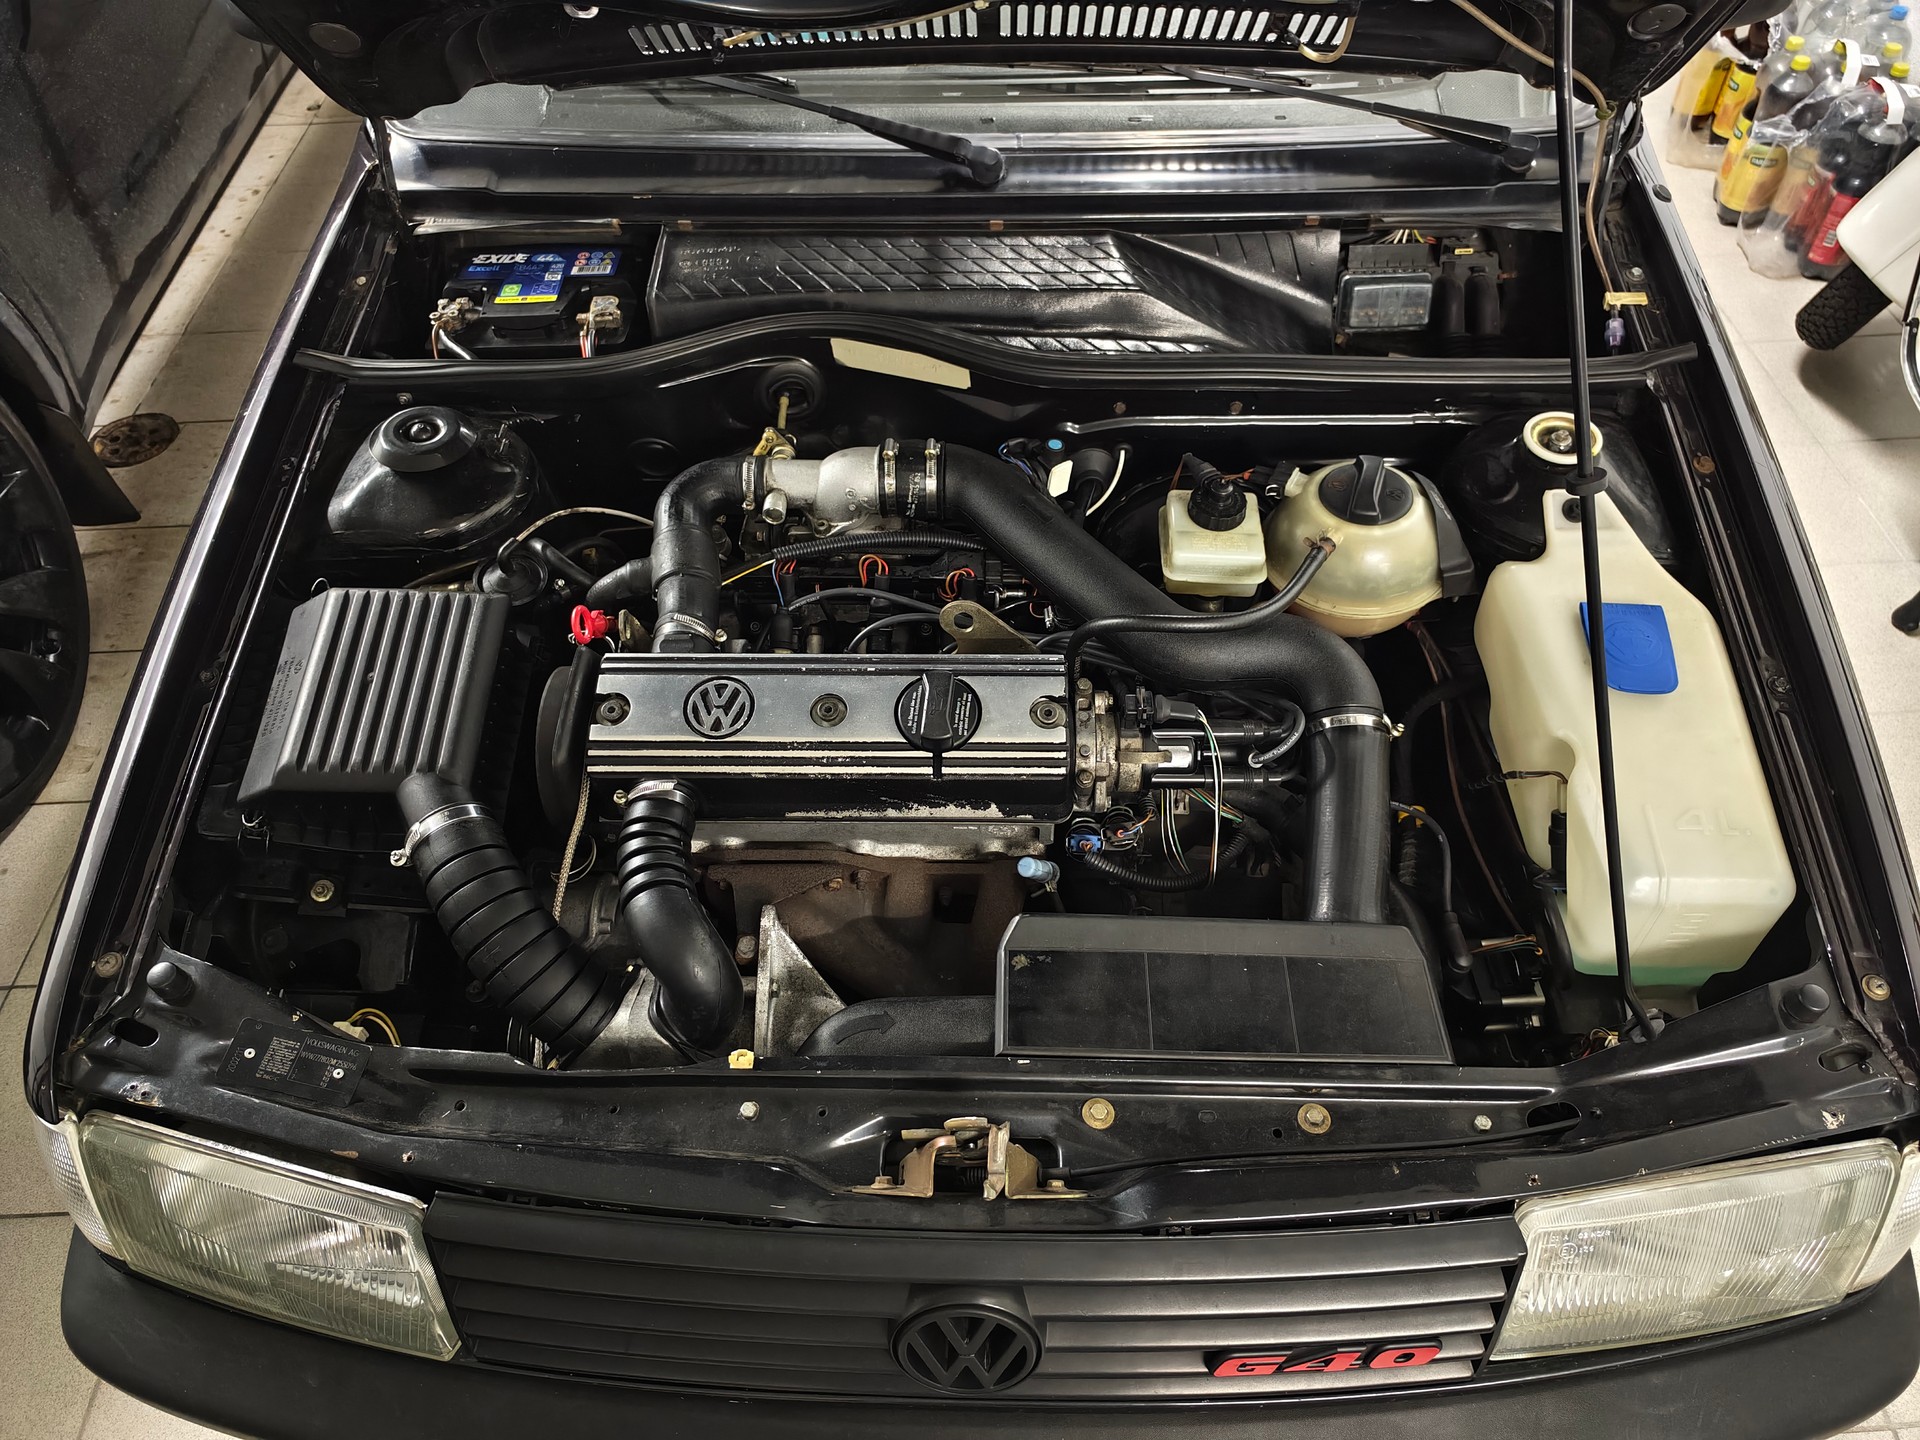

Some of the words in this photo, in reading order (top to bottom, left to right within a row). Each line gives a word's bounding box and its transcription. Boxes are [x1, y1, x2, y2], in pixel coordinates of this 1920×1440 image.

[472, 253, 530, 264] EXIDE
[537, 254, 554, 262] 44
[686, 678, 752, 737] VW
[307, 1038, 348, 1054] VOLKSWAGEN
[348, 1049, 360, 1057] AG
[897, 1308, 1038, 1392] VW
[1210, 1338, 1443, 1378] G40
